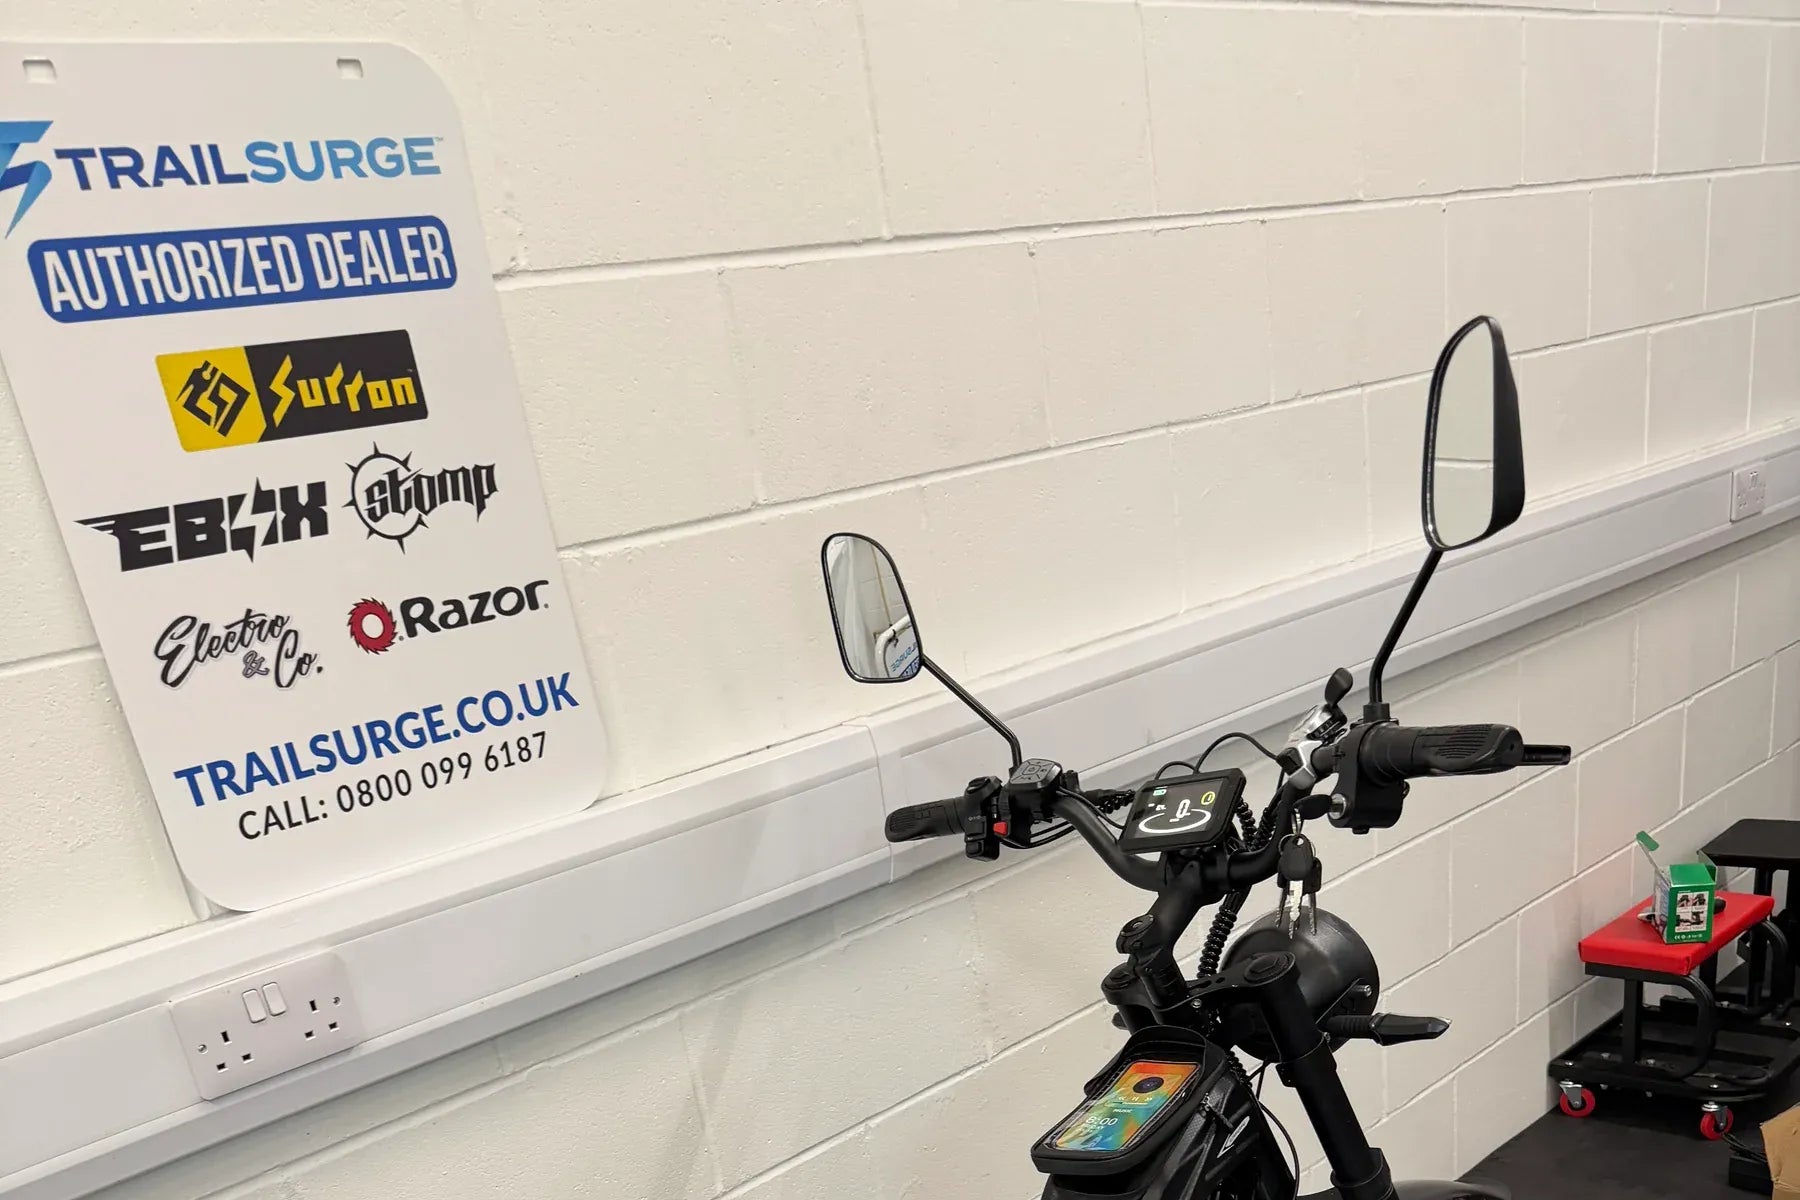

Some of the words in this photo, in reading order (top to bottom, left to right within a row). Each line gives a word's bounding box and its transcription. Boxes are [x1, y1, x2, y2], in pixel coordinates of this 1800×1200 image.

[54, 137, 442, 191] TRAILSURGE
[43, 235, 305, 313] AUTHORIZED
[306, 225, 452, 290] DEALER
[269, 354, 418, 428] Surron
[400, 580, 549, 638] Razor
[154, 608, 290, 688] Electro
[242, 650, 270, 679] &
[274, 629, 323, 688] Co.
[173, 672, 580, 808] TRAILSURGE.CO.UK
[238, 795, 329, 840] CALL:
[336, 768, 412, 813] 0800
[421, 751, 472, 790] 099
[484, 730, 547, 773] 6187
